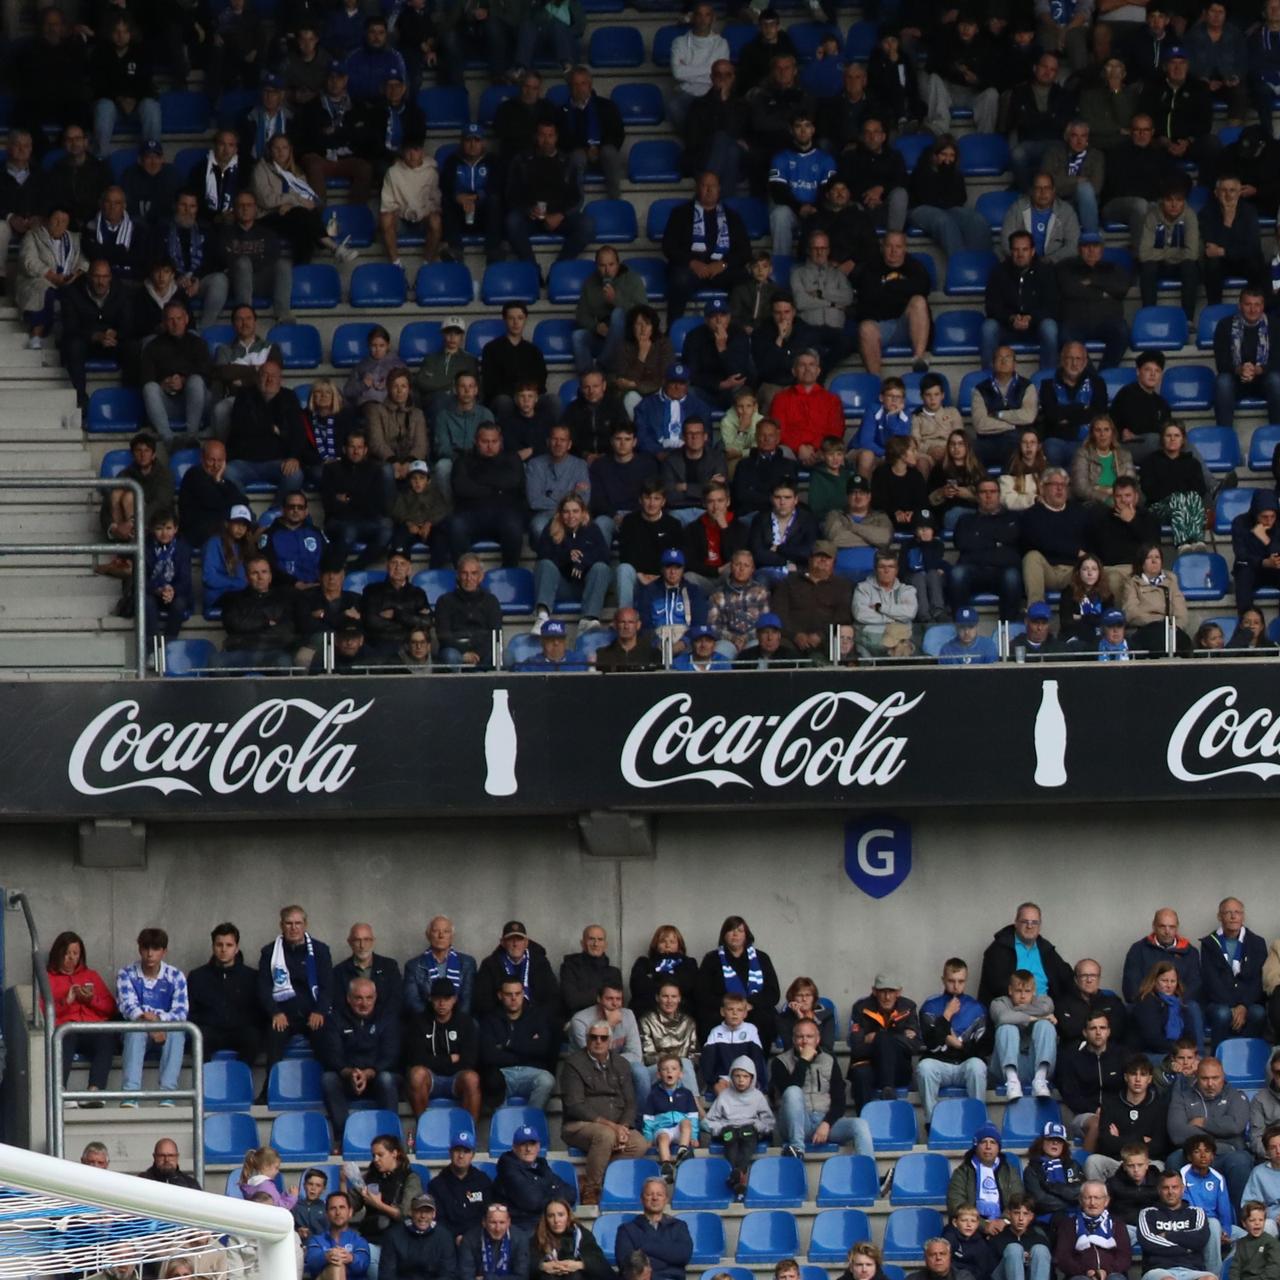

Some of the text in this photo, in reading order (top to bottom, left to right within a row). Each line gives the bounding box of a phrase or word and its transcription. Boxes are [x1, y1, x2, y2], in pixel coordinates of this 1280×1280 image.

[68, 698, 375, 796] Coca-Cola
[620, 690, 925, 789] Coca-Cola
[857, 828, 895, 877] G
[1155, 1219, 1191, 1231] adidas
